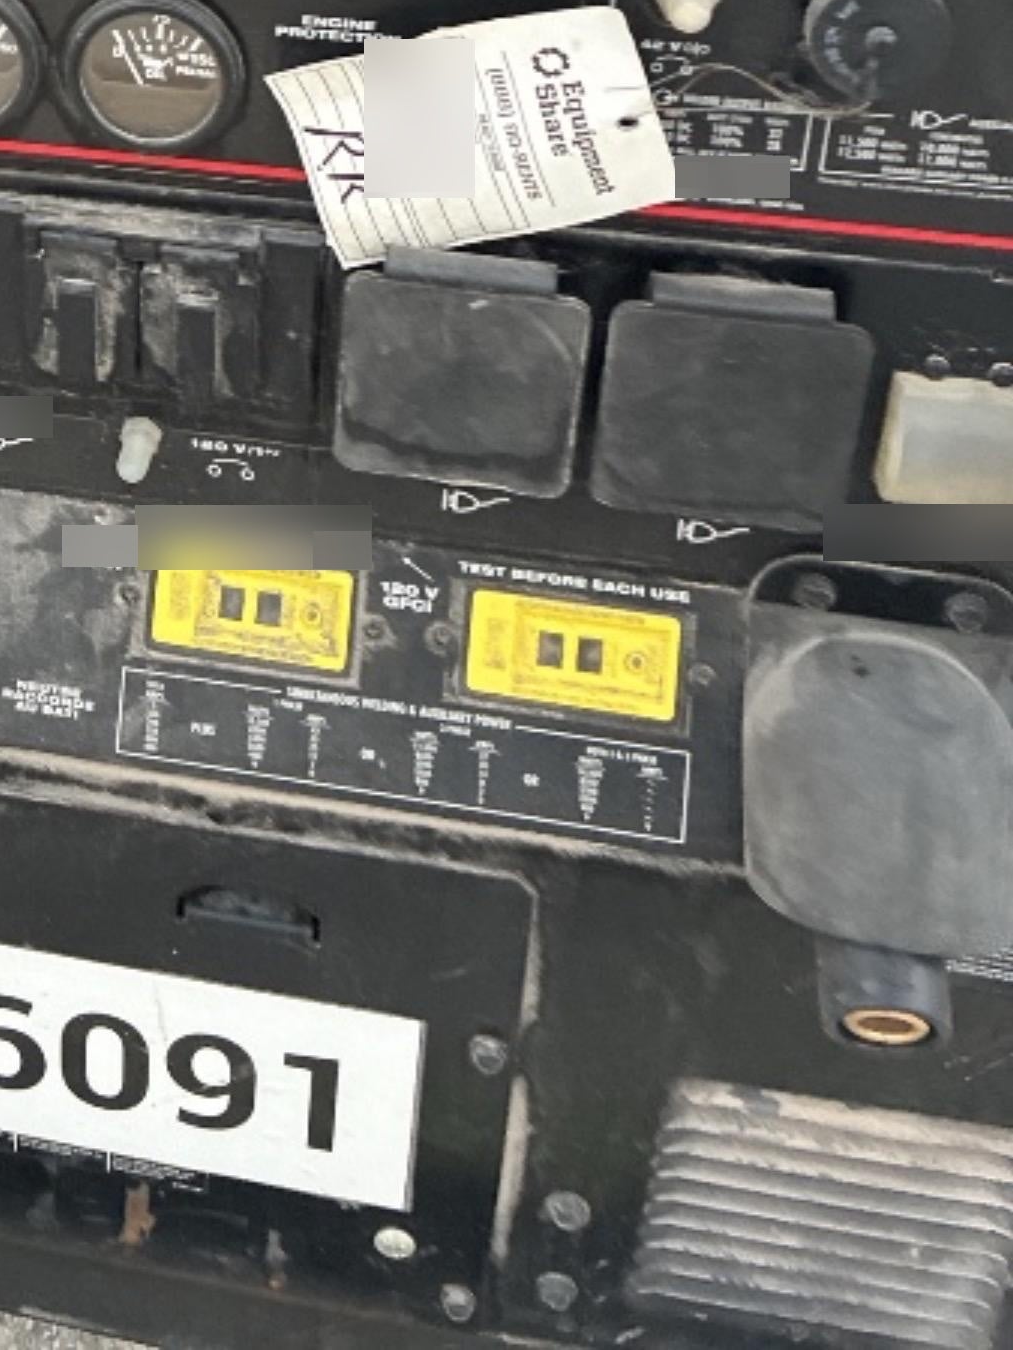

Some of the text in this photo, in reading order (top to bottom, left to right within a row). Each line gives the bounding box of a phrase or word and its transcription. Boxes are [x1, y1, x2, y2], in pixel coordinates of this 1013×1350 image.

[301, 13, 377, 31] ENGINE
[535, 81, 570, 157] Share
[562, 80, 616, 196] Equipment
[424, 585, 440, 601] V
[457, 560, 691, 604] TEST BEFORE EACH USE
